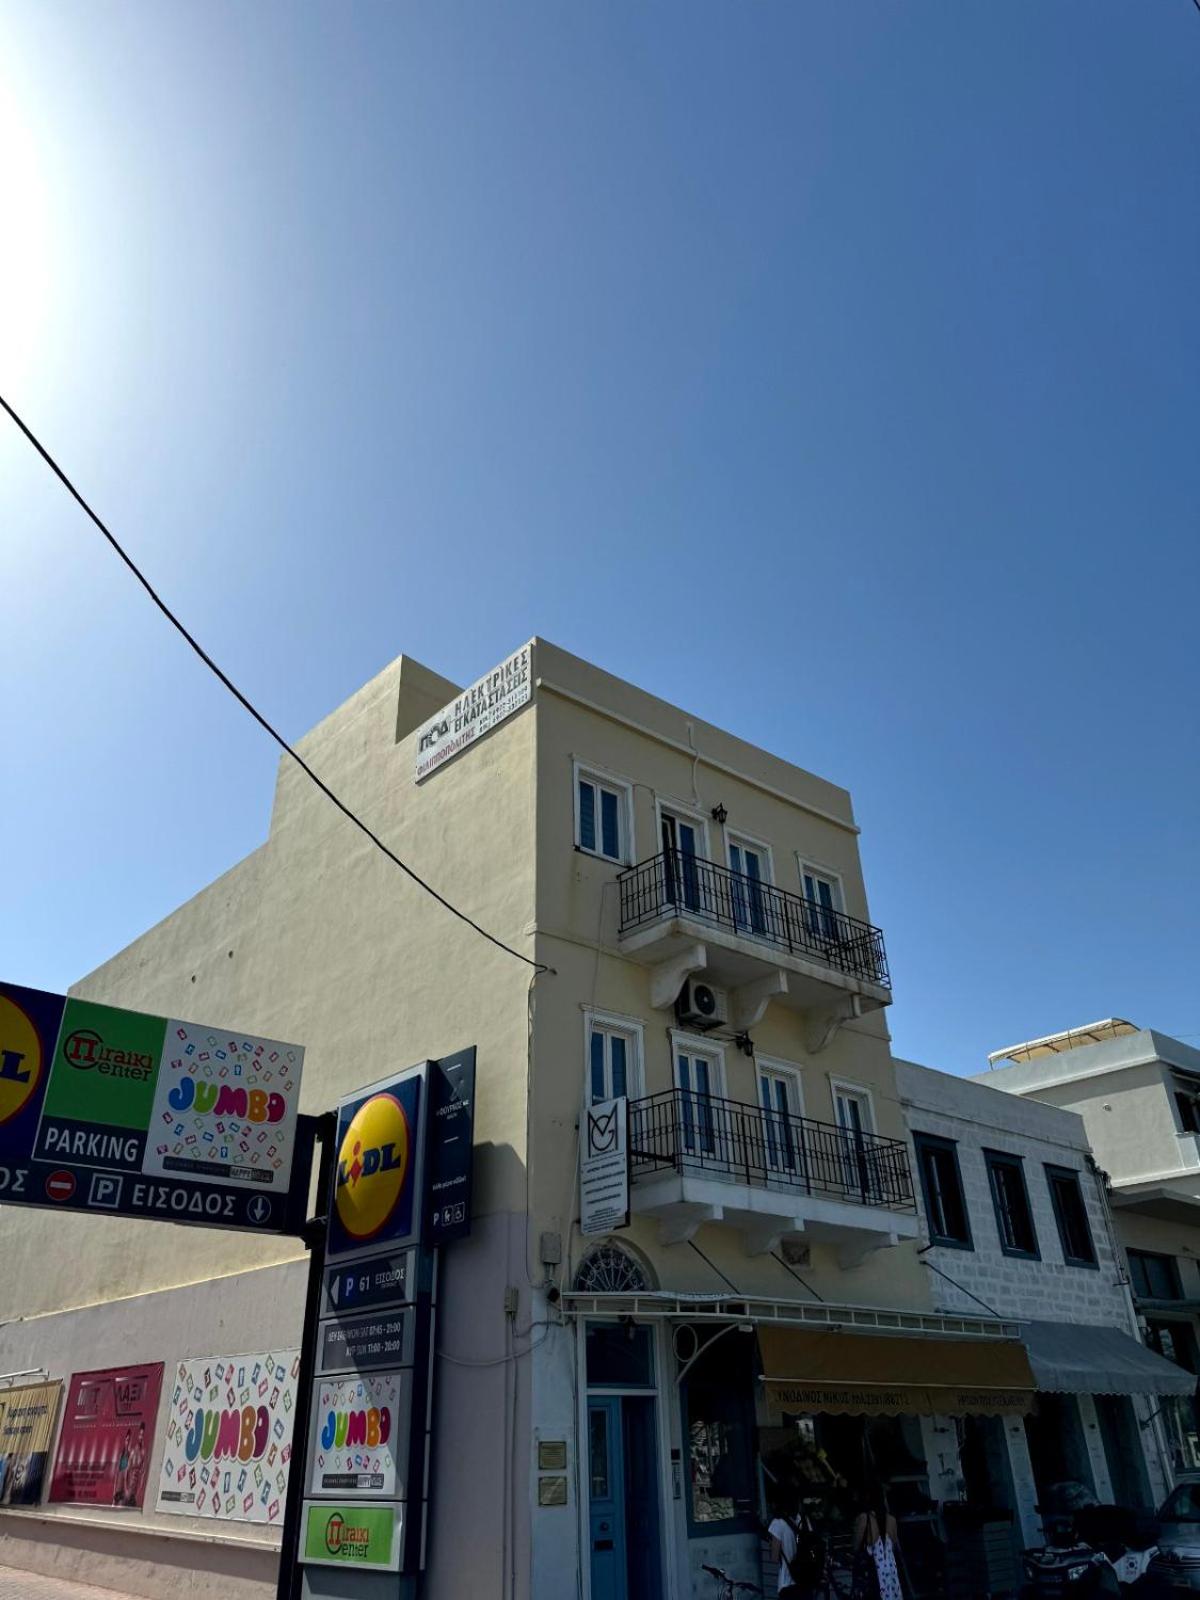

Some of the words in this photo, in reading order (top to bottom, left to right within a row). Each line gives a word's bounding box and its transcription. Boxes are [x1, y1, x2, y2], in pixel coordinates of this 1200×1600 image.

[168, 1076, 286, 1124] JUMBO
[45, 1127, 139, 1162] PARKING
[97, 1180, 113, 1200] P
[132, 1184, 236, 1216] ΕΙΣΟΔΟΣ
[345, 1278, 354, 1296] P
[359, 1276, 370, 1292] 61
[185, 1405, 270, 1463] JUMBO
[321, 1406, 391, 1450] JUMBO
